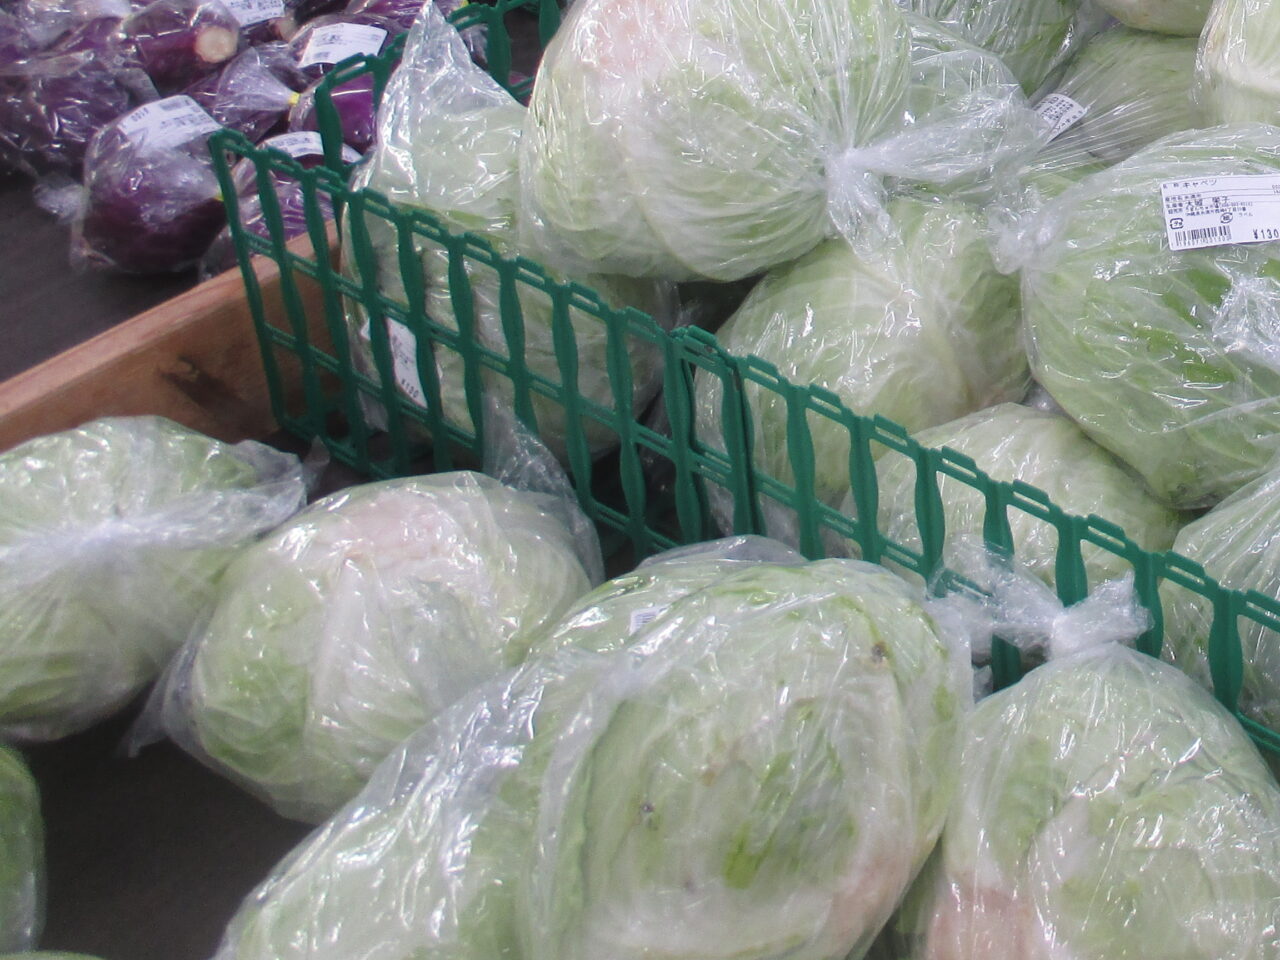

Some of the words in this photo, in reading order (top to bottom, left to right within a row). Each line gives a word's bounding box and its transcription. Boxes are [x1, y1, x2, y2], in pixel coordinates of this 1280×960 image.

[1183, 178, 1218, 188] キャベツ
[1253, 228, 1280, 240] ¥130
